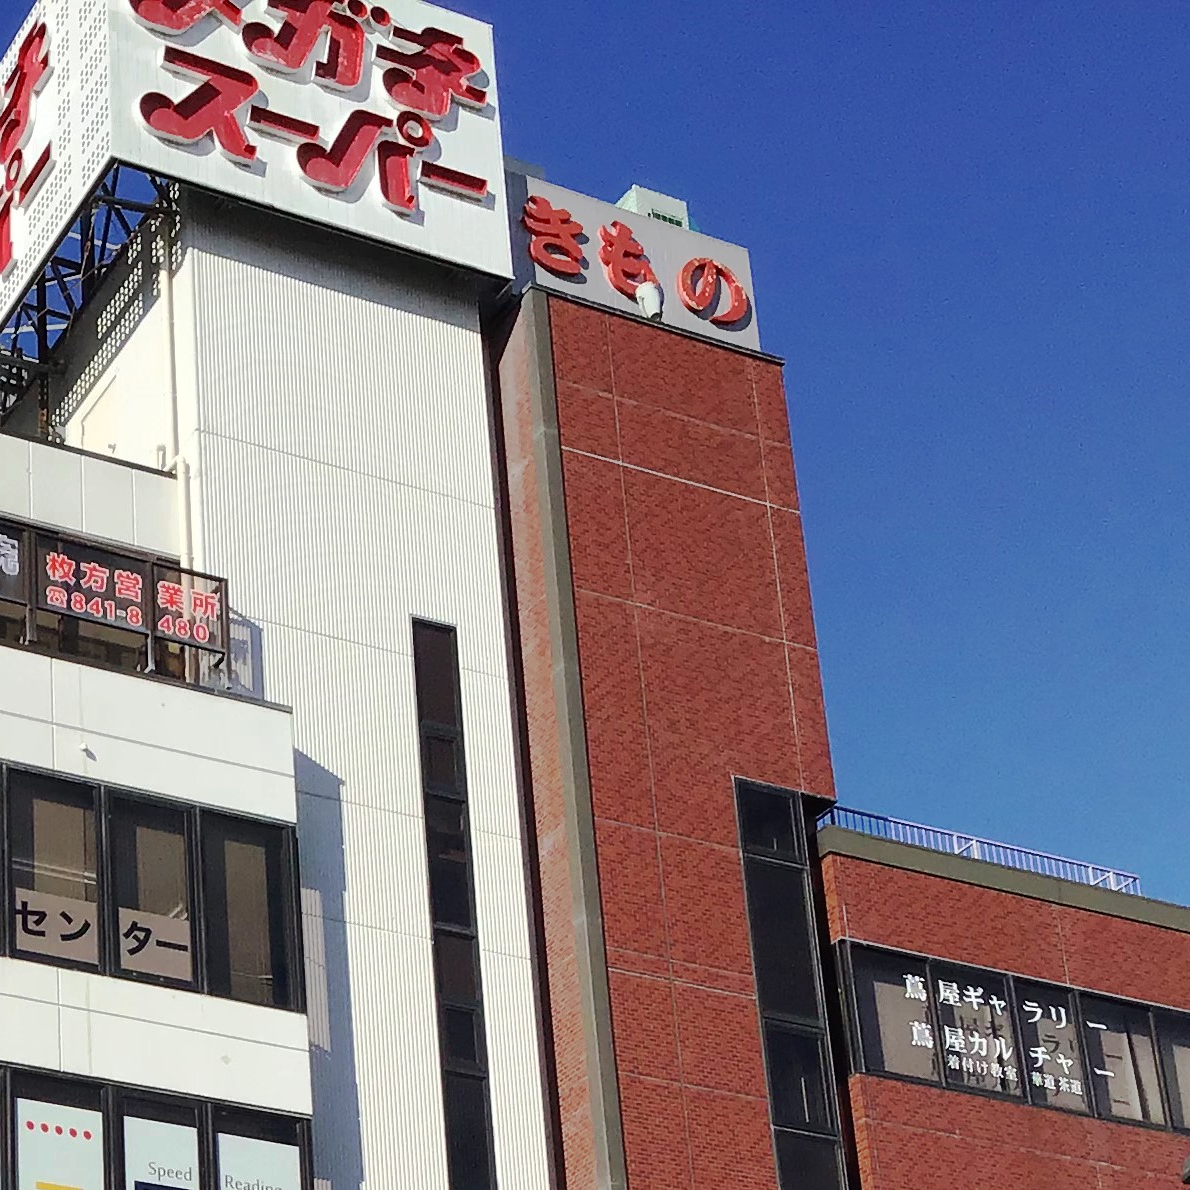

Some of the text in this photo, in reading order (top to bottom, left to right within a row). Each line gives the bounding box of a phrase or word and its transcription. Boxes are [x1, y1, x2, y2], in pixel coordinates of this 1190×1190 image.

[139, 45, 488, 212] スーパー
[522, 194, 749, 326] きもの
[46, 552, 221, 622] 枚方営業所
[148, 1161, 193, 1182] Speed
